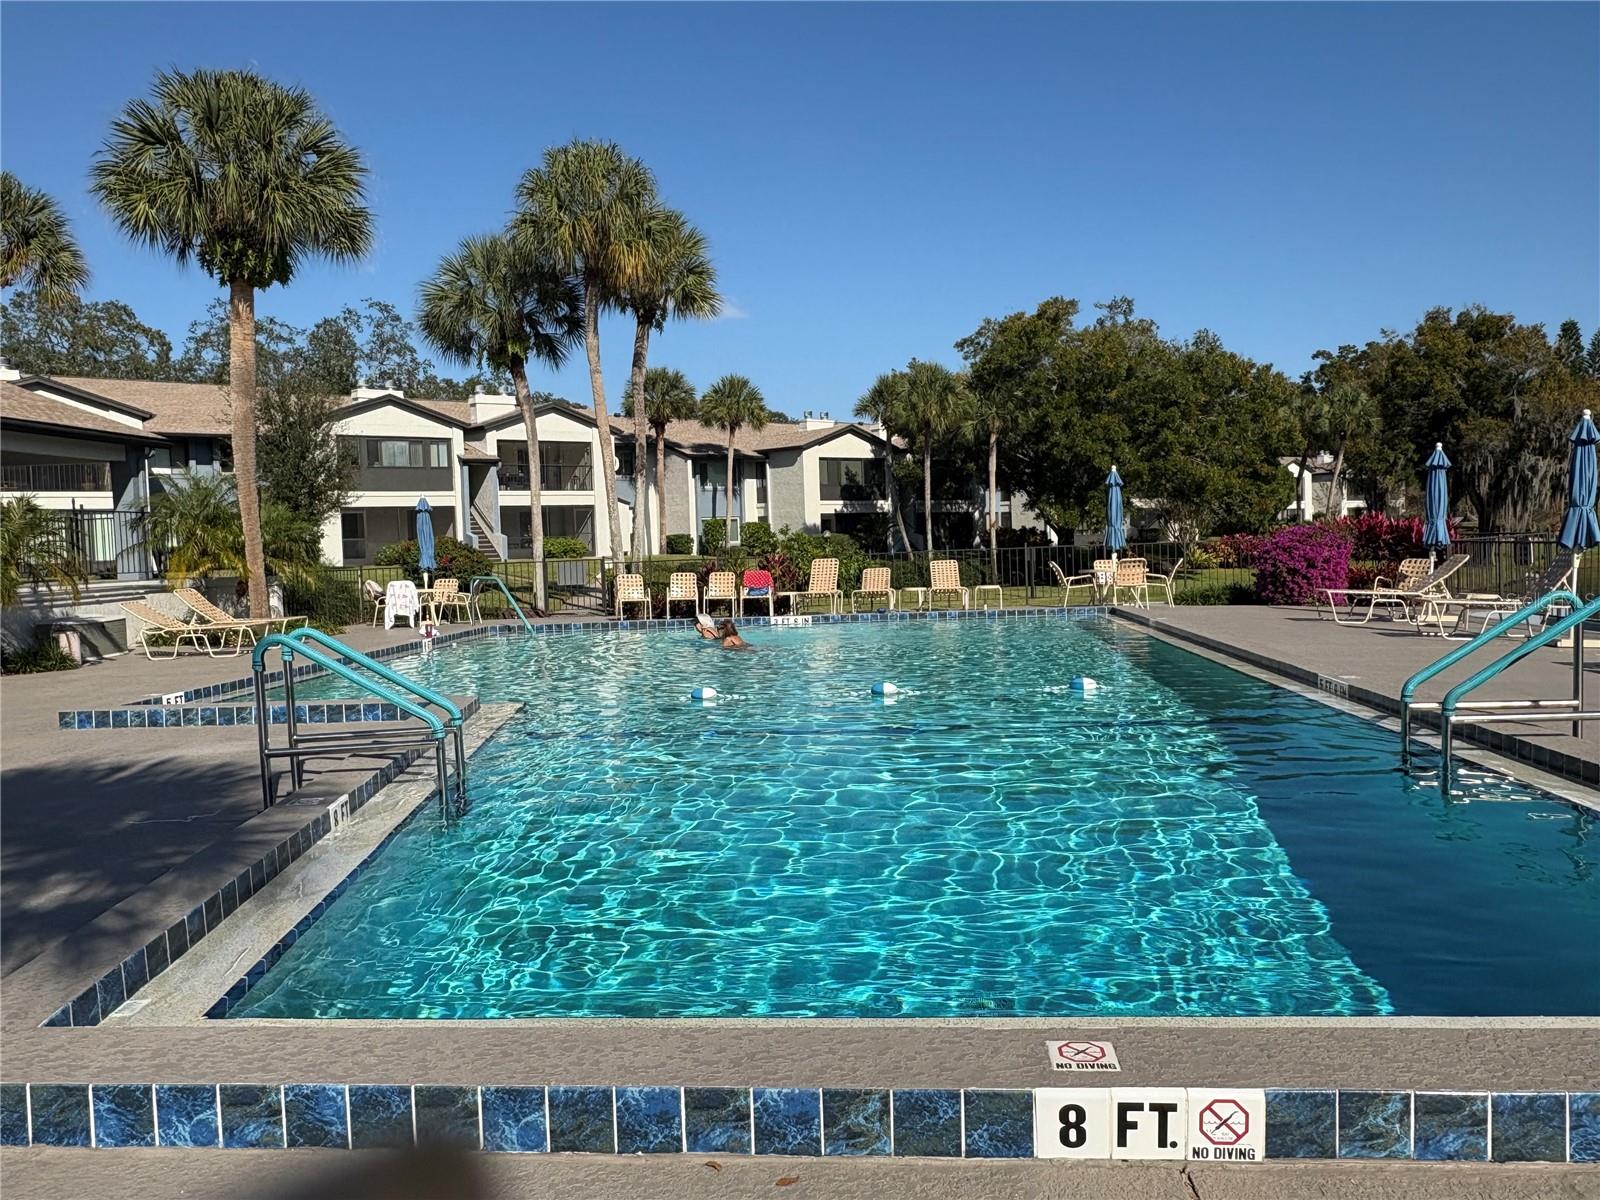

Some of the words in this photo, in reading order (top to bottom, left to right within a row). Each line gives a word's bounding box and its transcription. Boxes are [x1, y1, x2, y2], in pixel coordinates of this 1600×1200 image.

[333, 808, 339, 827] 8
[1055, 1062, 1073, 1070] NO
[1075, 1062, 1118, 1070] DIVING
[1058, 1103, 1087, 1149] 8
[1117, 1102, 1178, 1149] FT.
[1192, 1146, 1209, 1159] NO
[1213, 1146, 1256, 1161] DIVING
